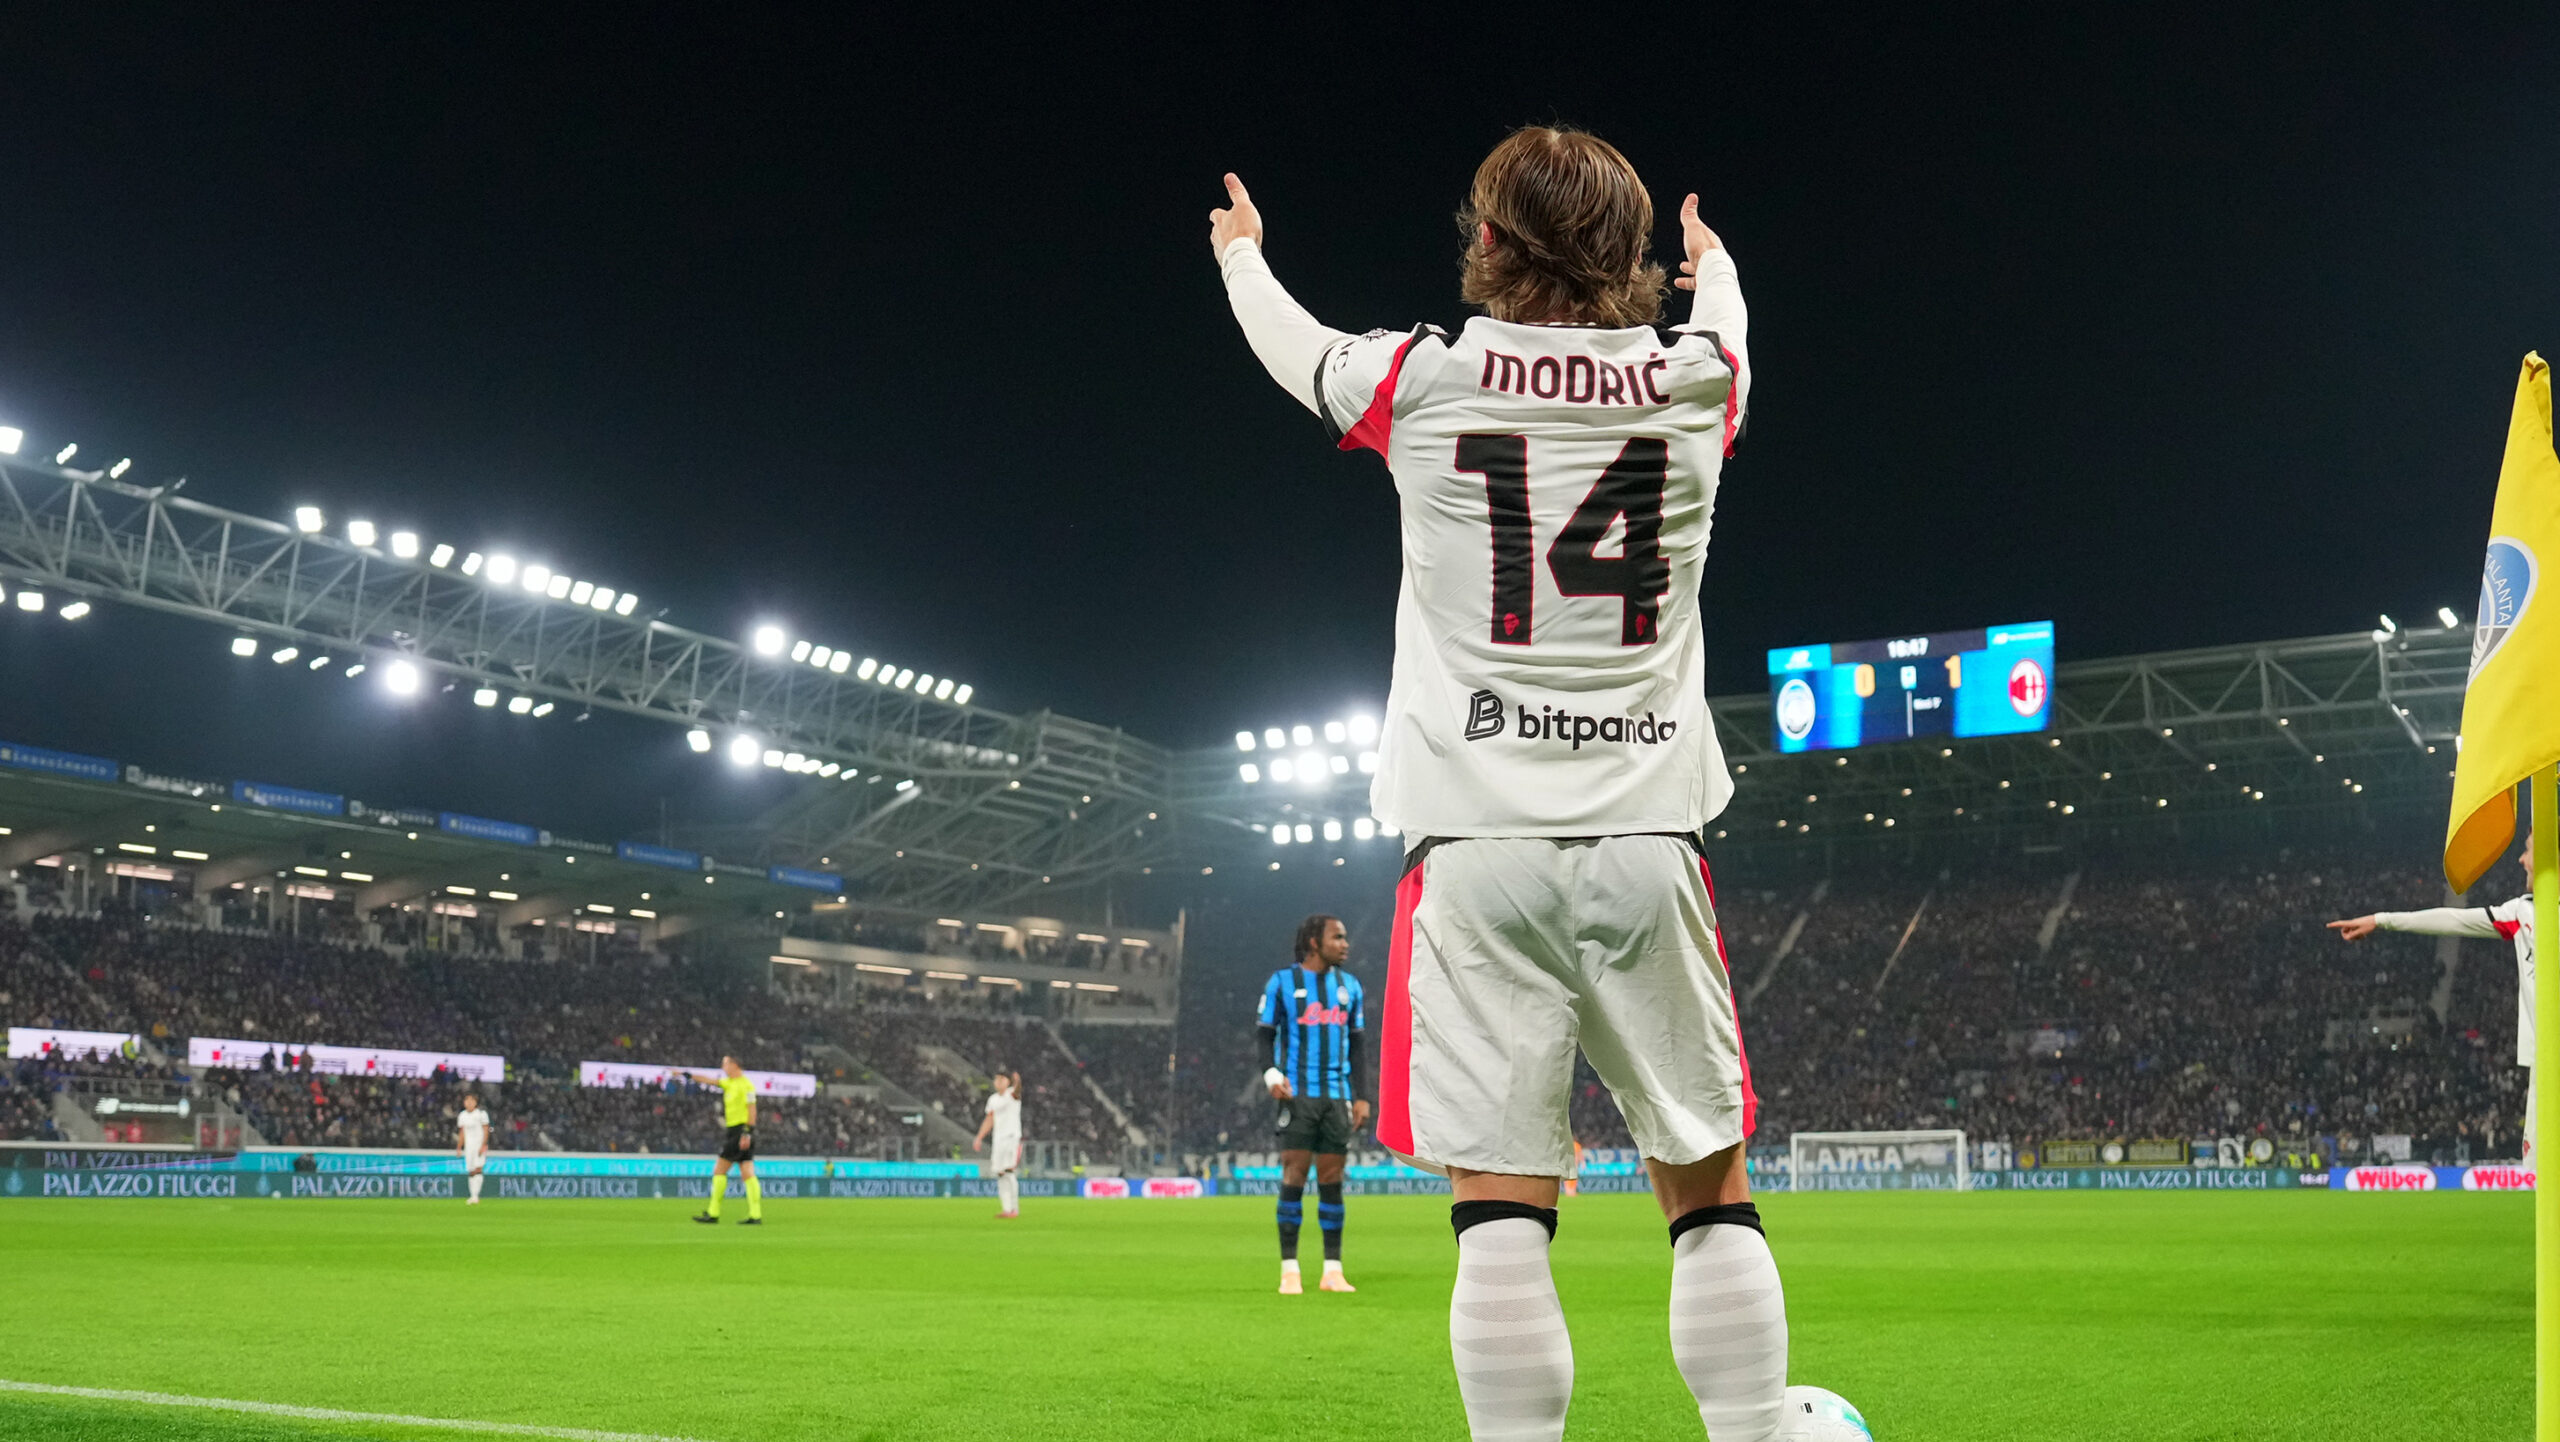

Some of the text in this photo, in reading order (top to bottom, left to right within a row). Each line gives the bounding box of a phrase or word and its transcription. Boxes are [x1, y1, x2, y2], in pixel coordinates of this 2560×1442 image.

[1480, 349, 1671, 407] MODRIĆ
[1454, 433, 1670, 646] 14
[2485, 553, 2513, 624] TALANTA
[1854, 654, 1961, 698] 0 1
[1518, 704, 1676, 750] bitpanda
[43, 1173, 236, 1197] PALAZZO FIUGGI
[292, 1175, 453, 1197] PALAZZO FIUGGI
[500, 1178, 638, 1197] PALAZZO FIUGGI
[830, 1180, 889, 1197] PALAZZO
[2101, 1170, 2267, 1189] PALAZZO FIUGGI
[2356, 1167, 2428, 1190] Wüber
[2473, 1167, 2536, 1190] Wübe
